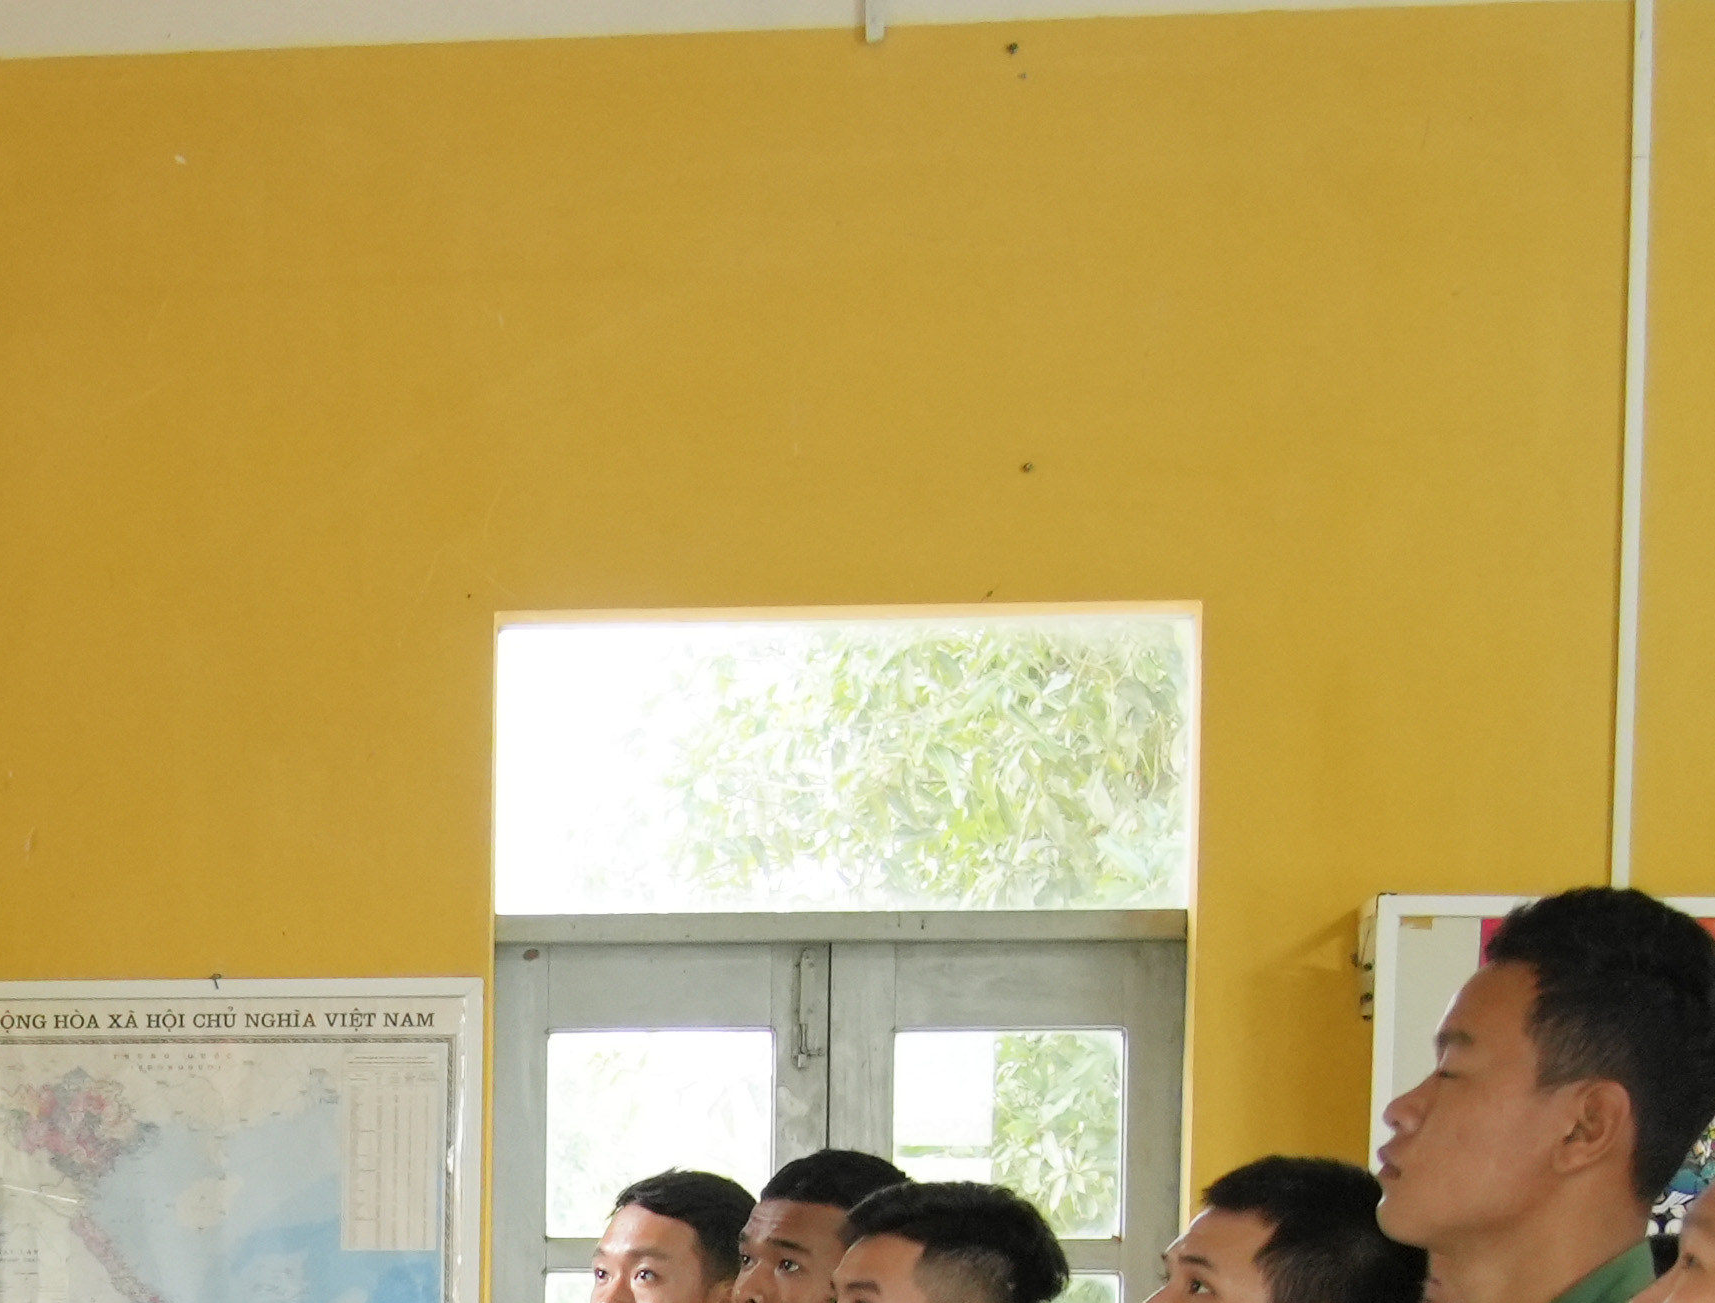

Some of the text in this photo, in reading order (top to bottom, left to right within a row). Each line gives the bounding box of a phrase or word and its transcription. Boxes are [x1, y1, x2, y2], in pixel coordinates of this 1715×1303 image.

[53, 1009, 100, 1029] HÒA
[146, 1008, 185, 1032] HỘI
[192, 1006, 237, 1029] CHỦ
[324, 1007, 377, 1032] VIỆT
[383, 1012, 435, 1028] NAM
